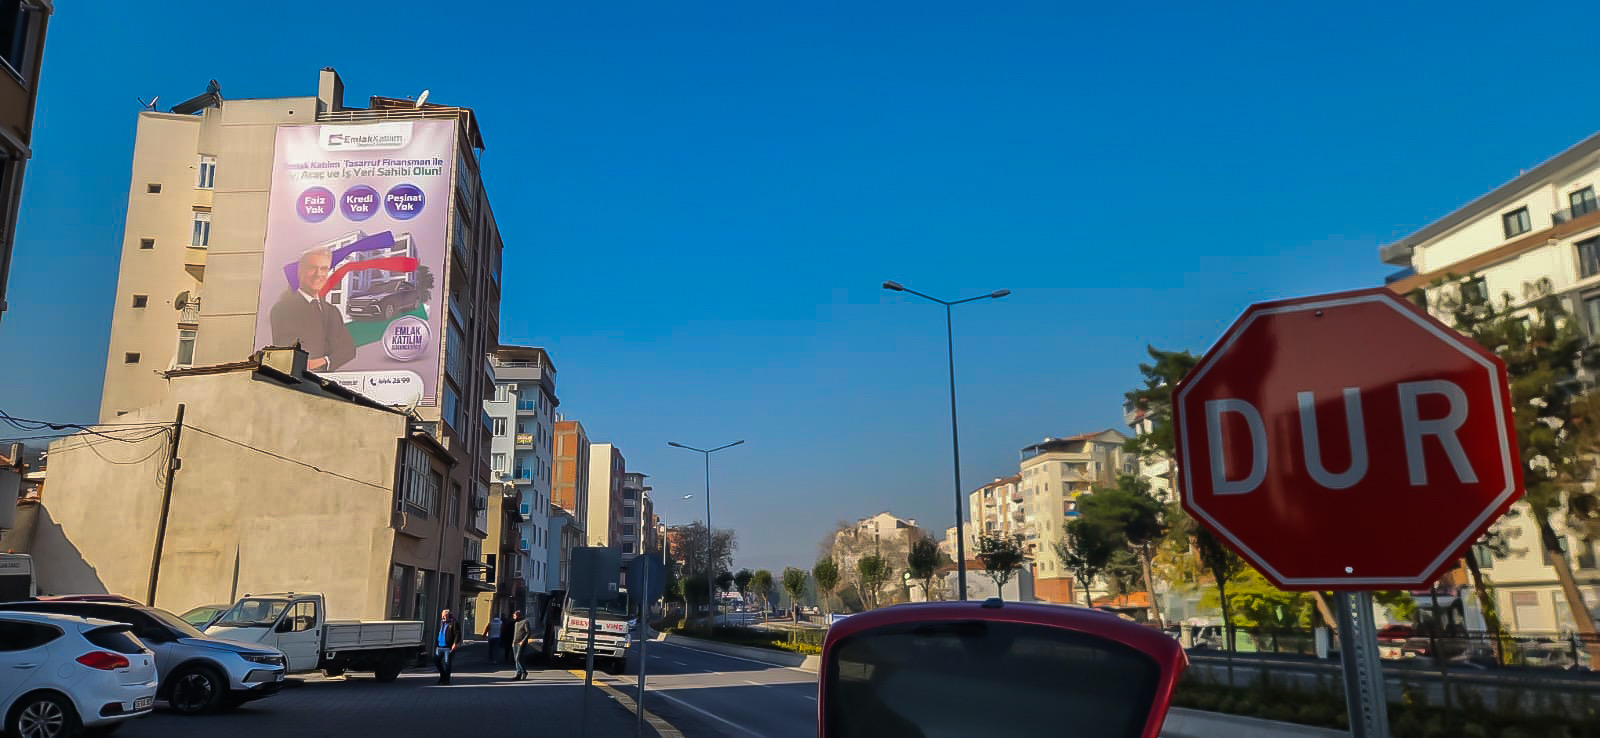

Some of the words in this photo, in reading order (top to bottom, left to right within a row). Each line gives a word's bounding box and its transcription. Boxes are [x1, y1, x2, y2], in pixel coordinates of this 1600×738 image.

[382, 158, 431, 167] Finansman
[433, 157, 443, 166] ile
[327, 170, 340, 178] ve
[353, 166, 375, 177] Yeri
[377, 166, 411, 177] Sahibi
[412, 166, 442, 176] Olun!
[304, 196, 326, 205] Faiz
[346, 194, 373, 204] Kredi
[387, 193, 422, 204] Peşinat
[305, 206, 324, 214] Yok
[350, 204, 368, 212] Yok
[395, 202, 414, 211] Yok
[395, 326, 421, 336] EMLAK
[392, 335, 422, 345] KATILIM
[1205, 379, 1479, 495] DUR
